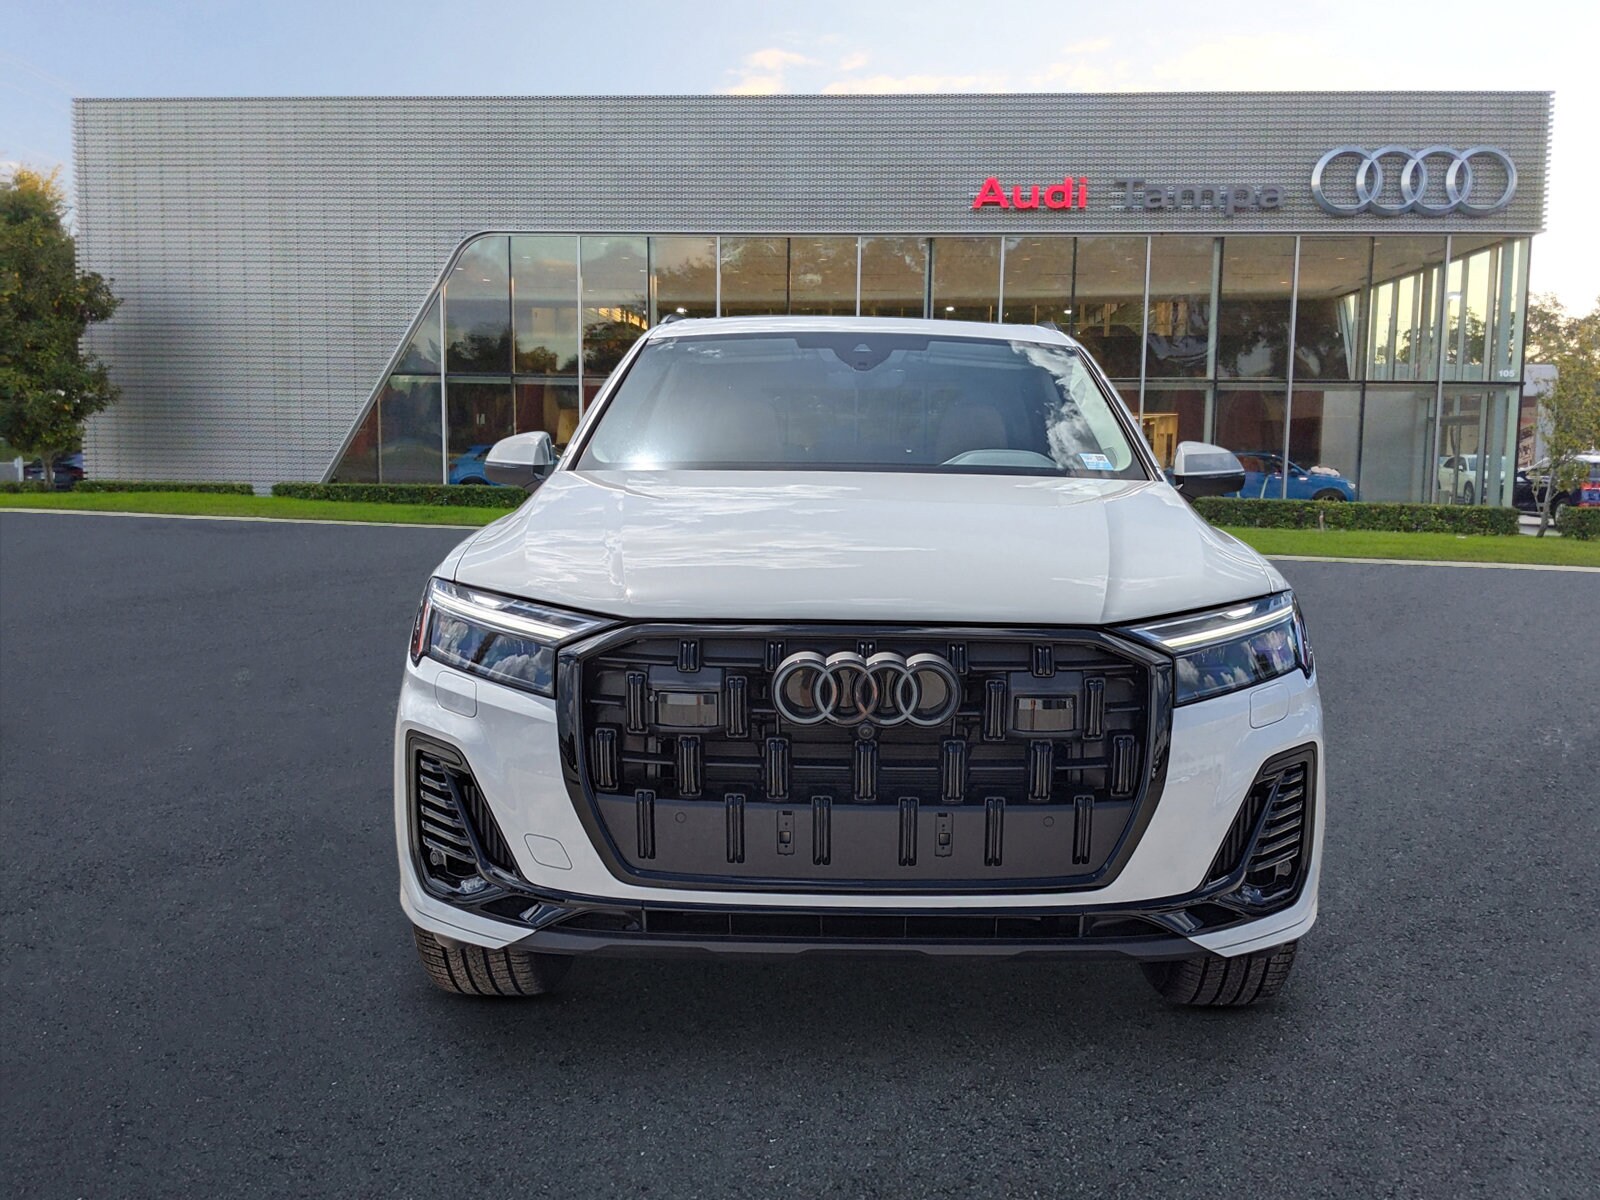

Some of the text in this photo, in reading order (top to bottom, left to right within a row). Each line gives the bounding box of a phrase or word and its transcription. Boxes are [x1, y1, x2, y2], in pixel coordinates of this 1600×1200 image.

[972, 176, 1284, 218] Audi Tampa
[1499, 369, 1515, 378] 105
